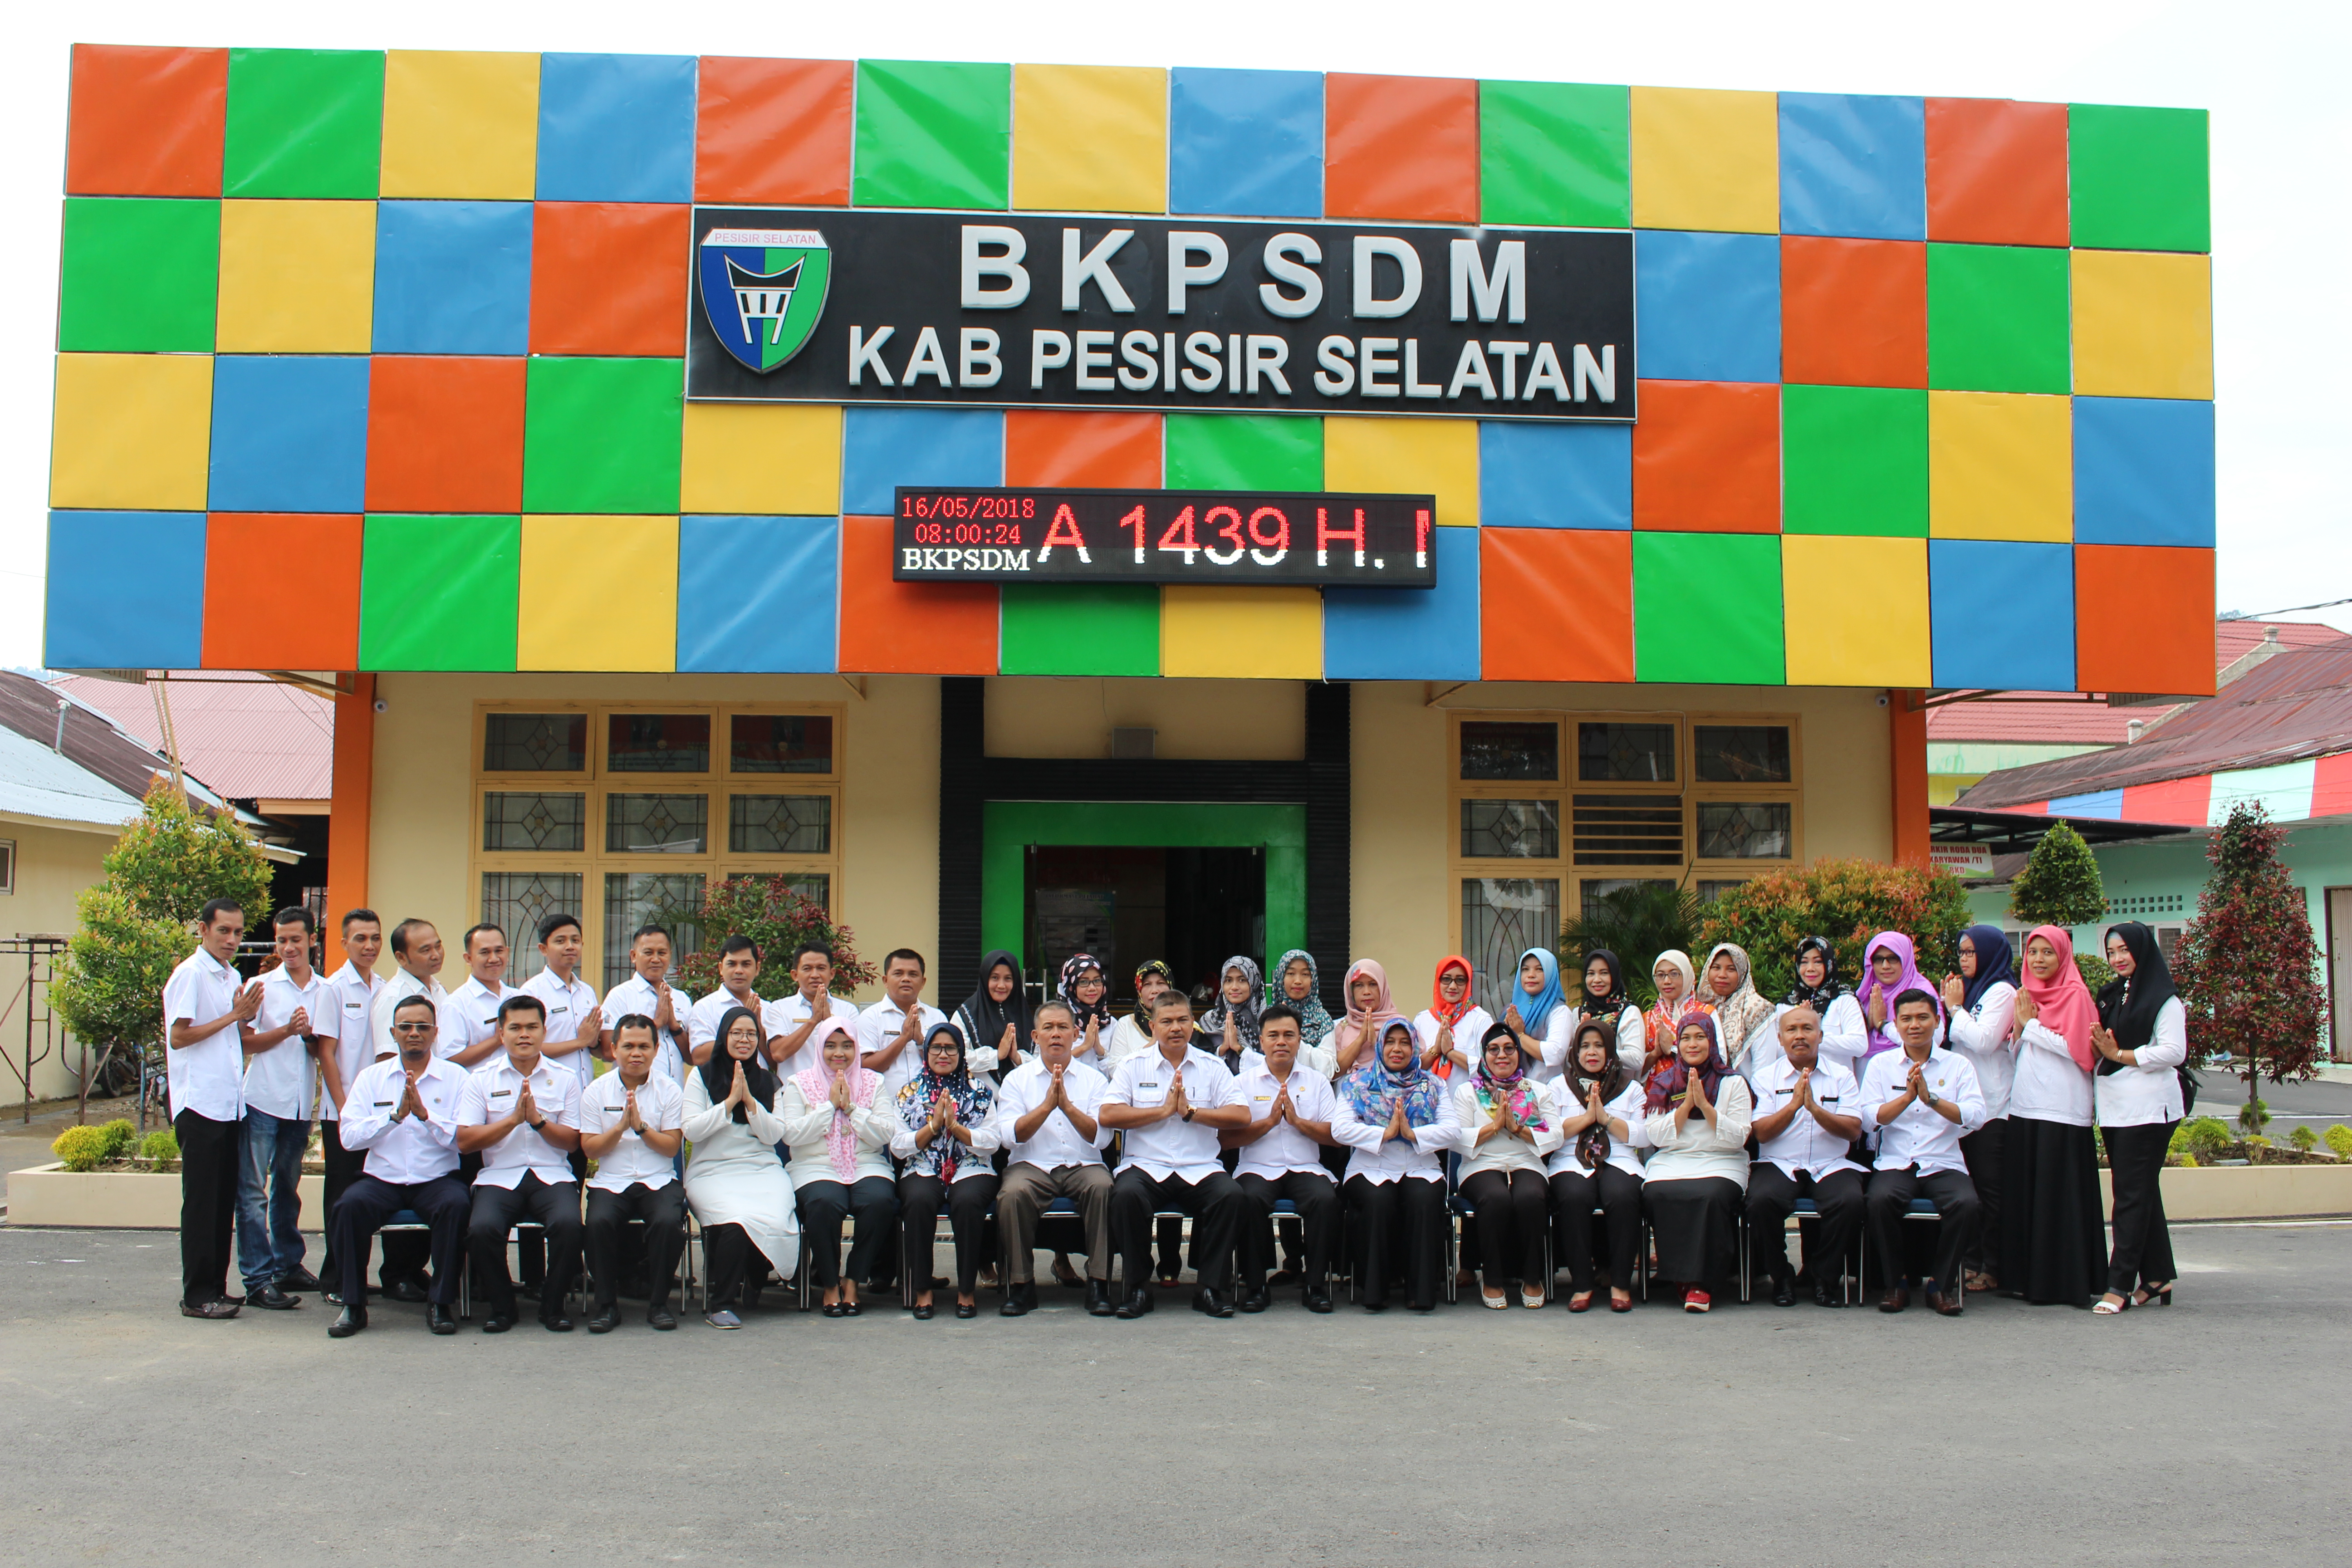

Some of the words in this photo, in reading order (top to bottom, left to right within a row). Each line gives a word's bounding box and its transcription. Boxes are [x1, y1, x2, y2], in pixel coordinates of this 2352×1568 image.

[715, 233, 760, 243] PESISIR
[764, 234, 816, 244] SELATAN
[848, 325, 1004, 387] KAB
[1030, 329, 1293, 394] PESISIR
[1313, 335, 1616, 404] SELATAN
[902, 497, 1035, 519] 16/05/2018
[915, 523, 1021, 544] 08:00:24
[1037, 503, 1092, 564] A
[1119, 505, 1290, 566] 1439
[1317, 508, 1385, 569] H.
[902, 548, 1030, 571] BKPSDM
